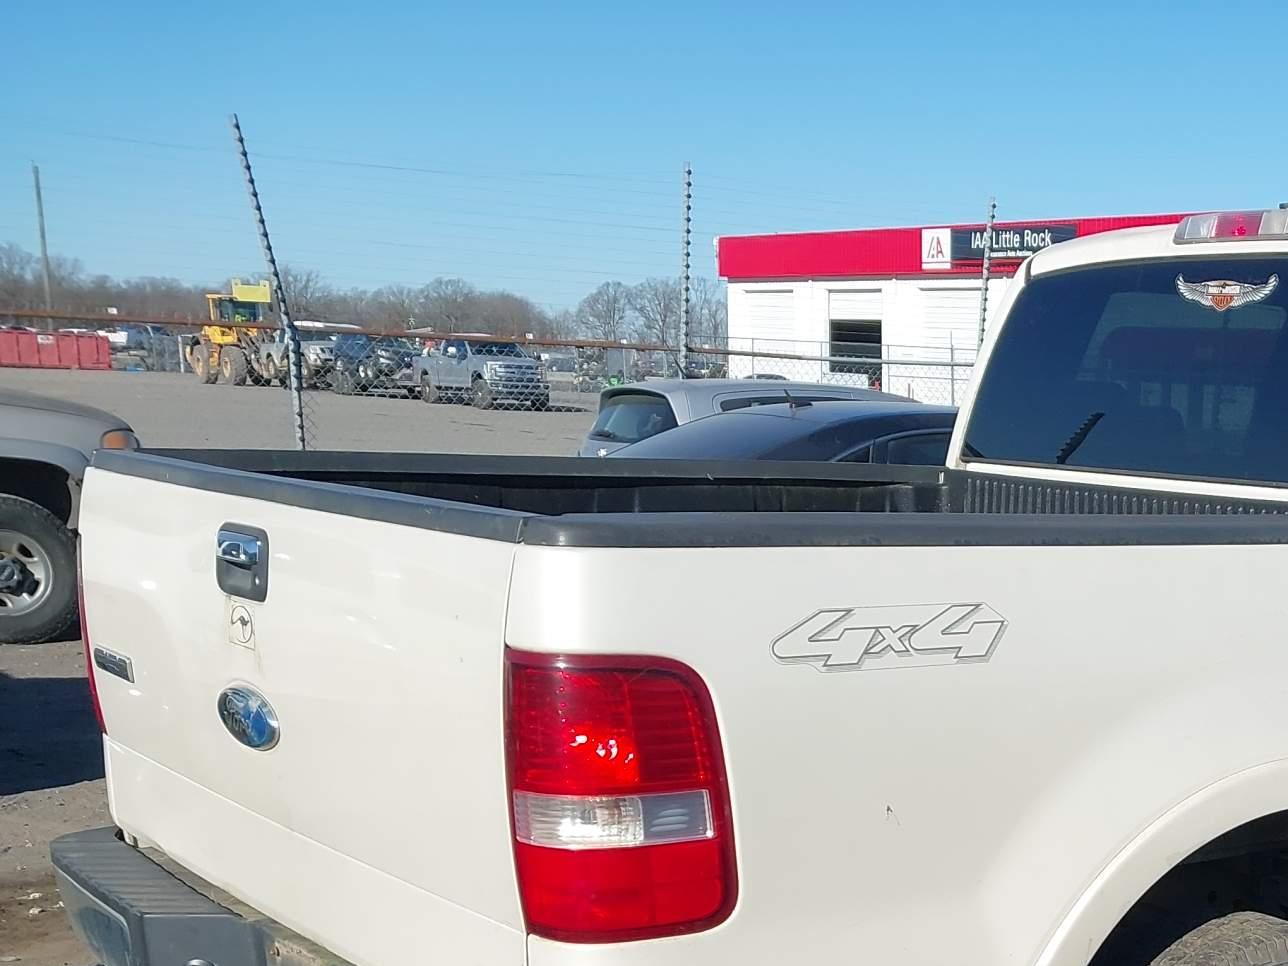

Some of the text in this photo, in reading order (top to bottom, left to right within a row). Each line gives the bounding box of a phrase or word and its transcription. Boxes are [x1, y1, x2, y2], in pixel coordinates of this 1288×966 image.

[992, 230, 1019, 248] Little
[1023, 229, 1051, 247] Rock
[771, 603, 1008, 667] 4x4
